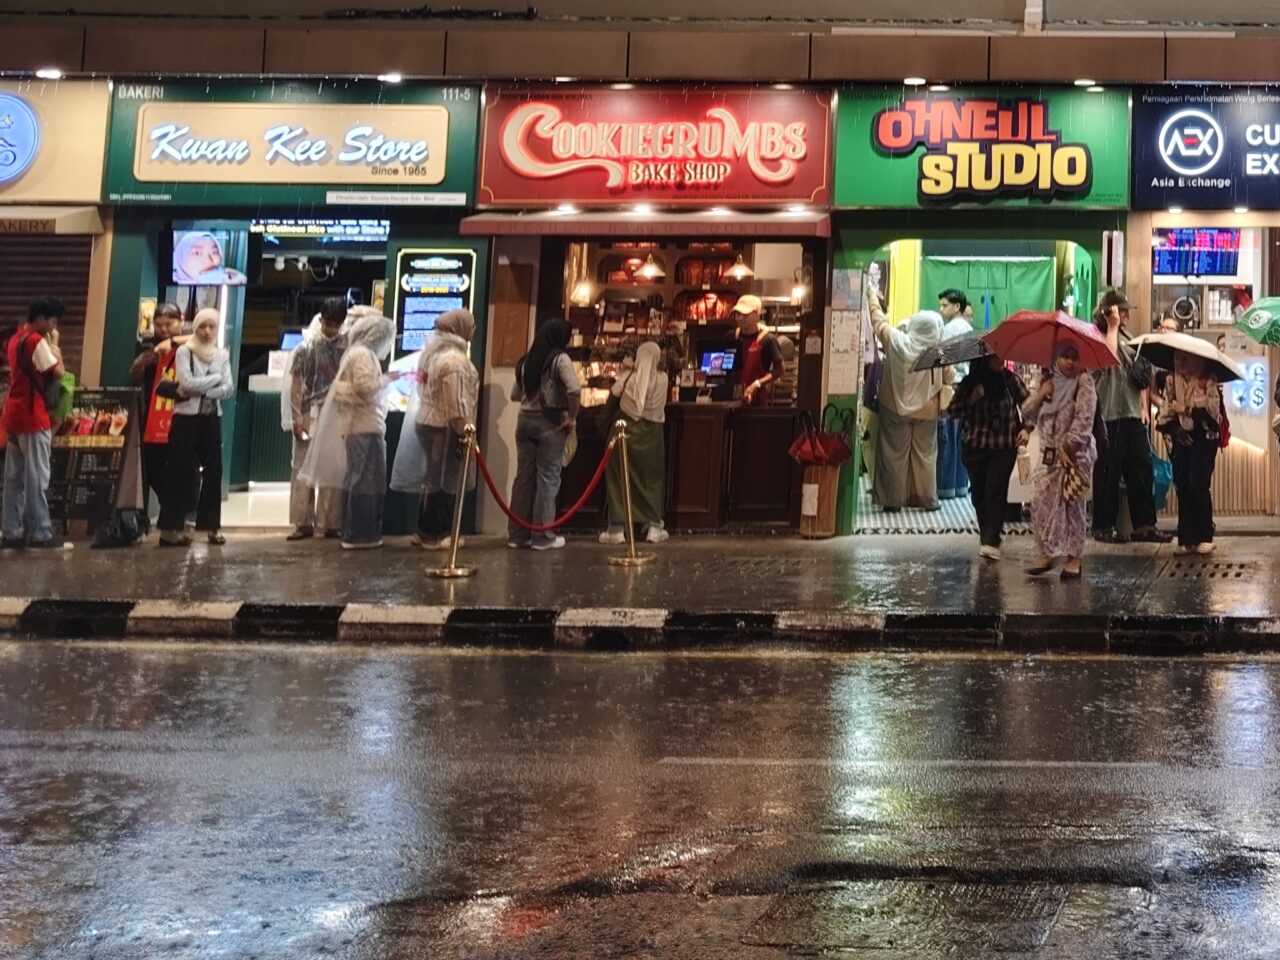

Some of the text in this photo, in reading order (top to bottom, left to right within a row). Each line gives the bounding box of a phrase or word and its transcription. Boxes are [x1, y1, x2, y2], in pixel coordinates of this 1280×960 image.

[118, 85, 164, 99] BAKERI
[1142, 95, 1183, 104] Perniagaan
[1234, 95, 1255, 104] Wang
[149, 124, 428, 162] Kwan Kee Store
[501, 102, 808, 187] COOKIECRUMBS
[371, 166, 427, 176] Since 1965
[628, 161, 732, 183] BAKE SHOP
[921, 142, 1088, 195] STUDIO
[1151, 177, 1175, 187] Asia
[307, 224, 325, 235] Rice
